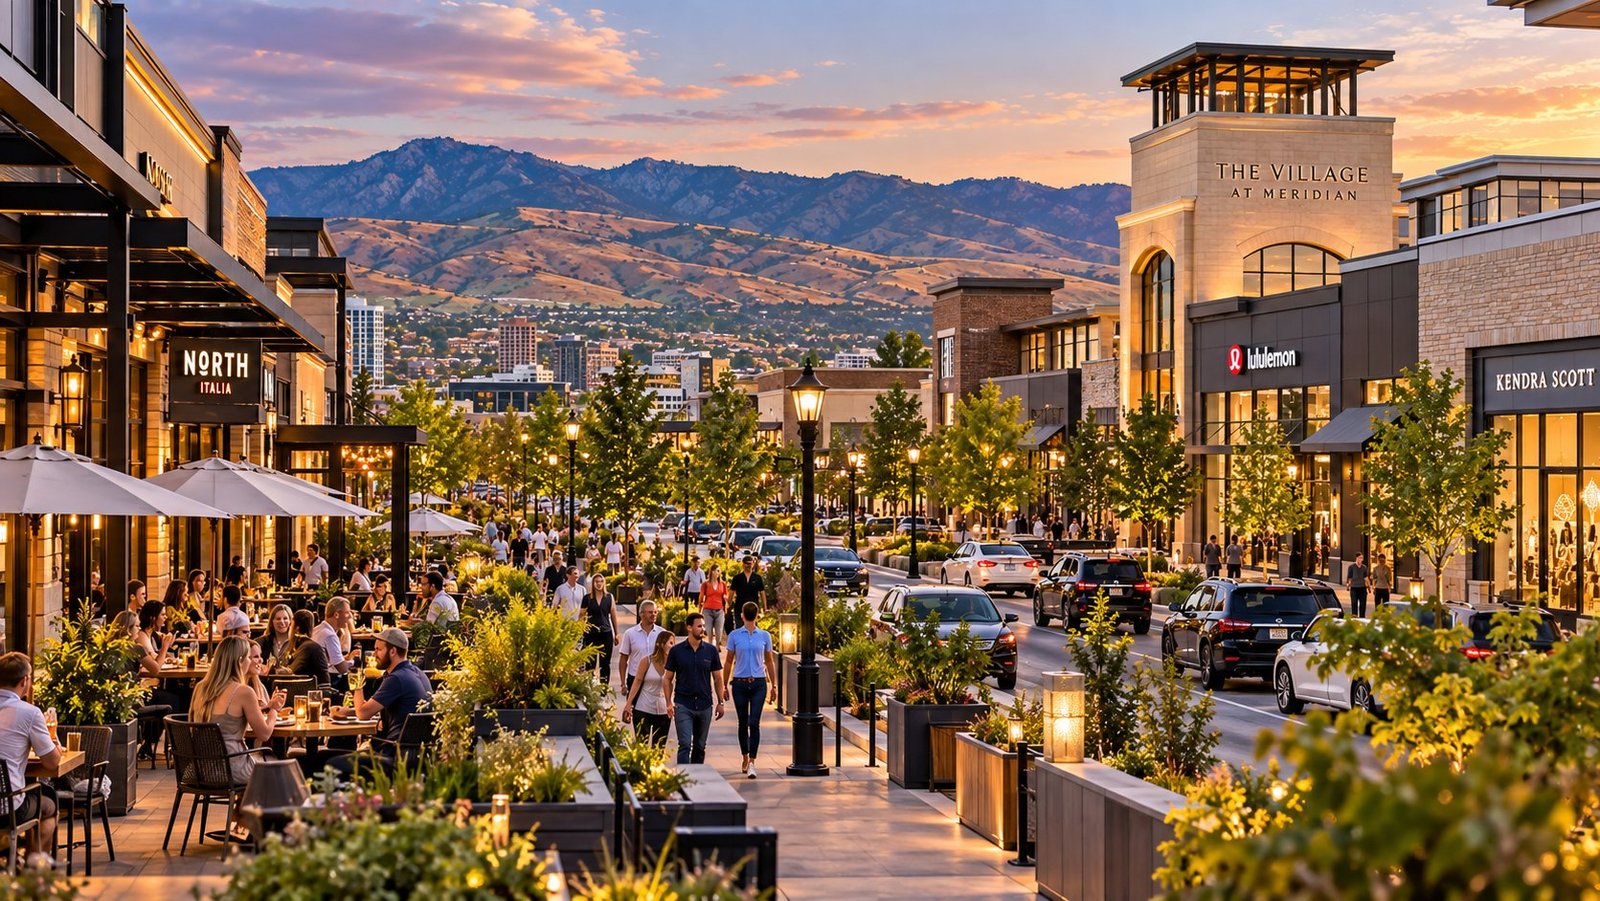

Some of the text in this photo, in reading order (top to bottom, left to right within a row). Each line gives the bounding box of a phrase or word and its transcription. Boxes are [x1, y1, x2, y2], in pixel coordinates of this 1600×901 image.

[1216, 162, 1368, 183] THE VILLAGE
[1231, 187, 1357, 201] AT MERIDIAN
[184, 349, 248, 378] NORTH
[1247, 346, 1296, 370] lululemon
[200, 381, 232, 395] ITALIA
[1496, 367, 1595, 391] KENDRA SCOTT
